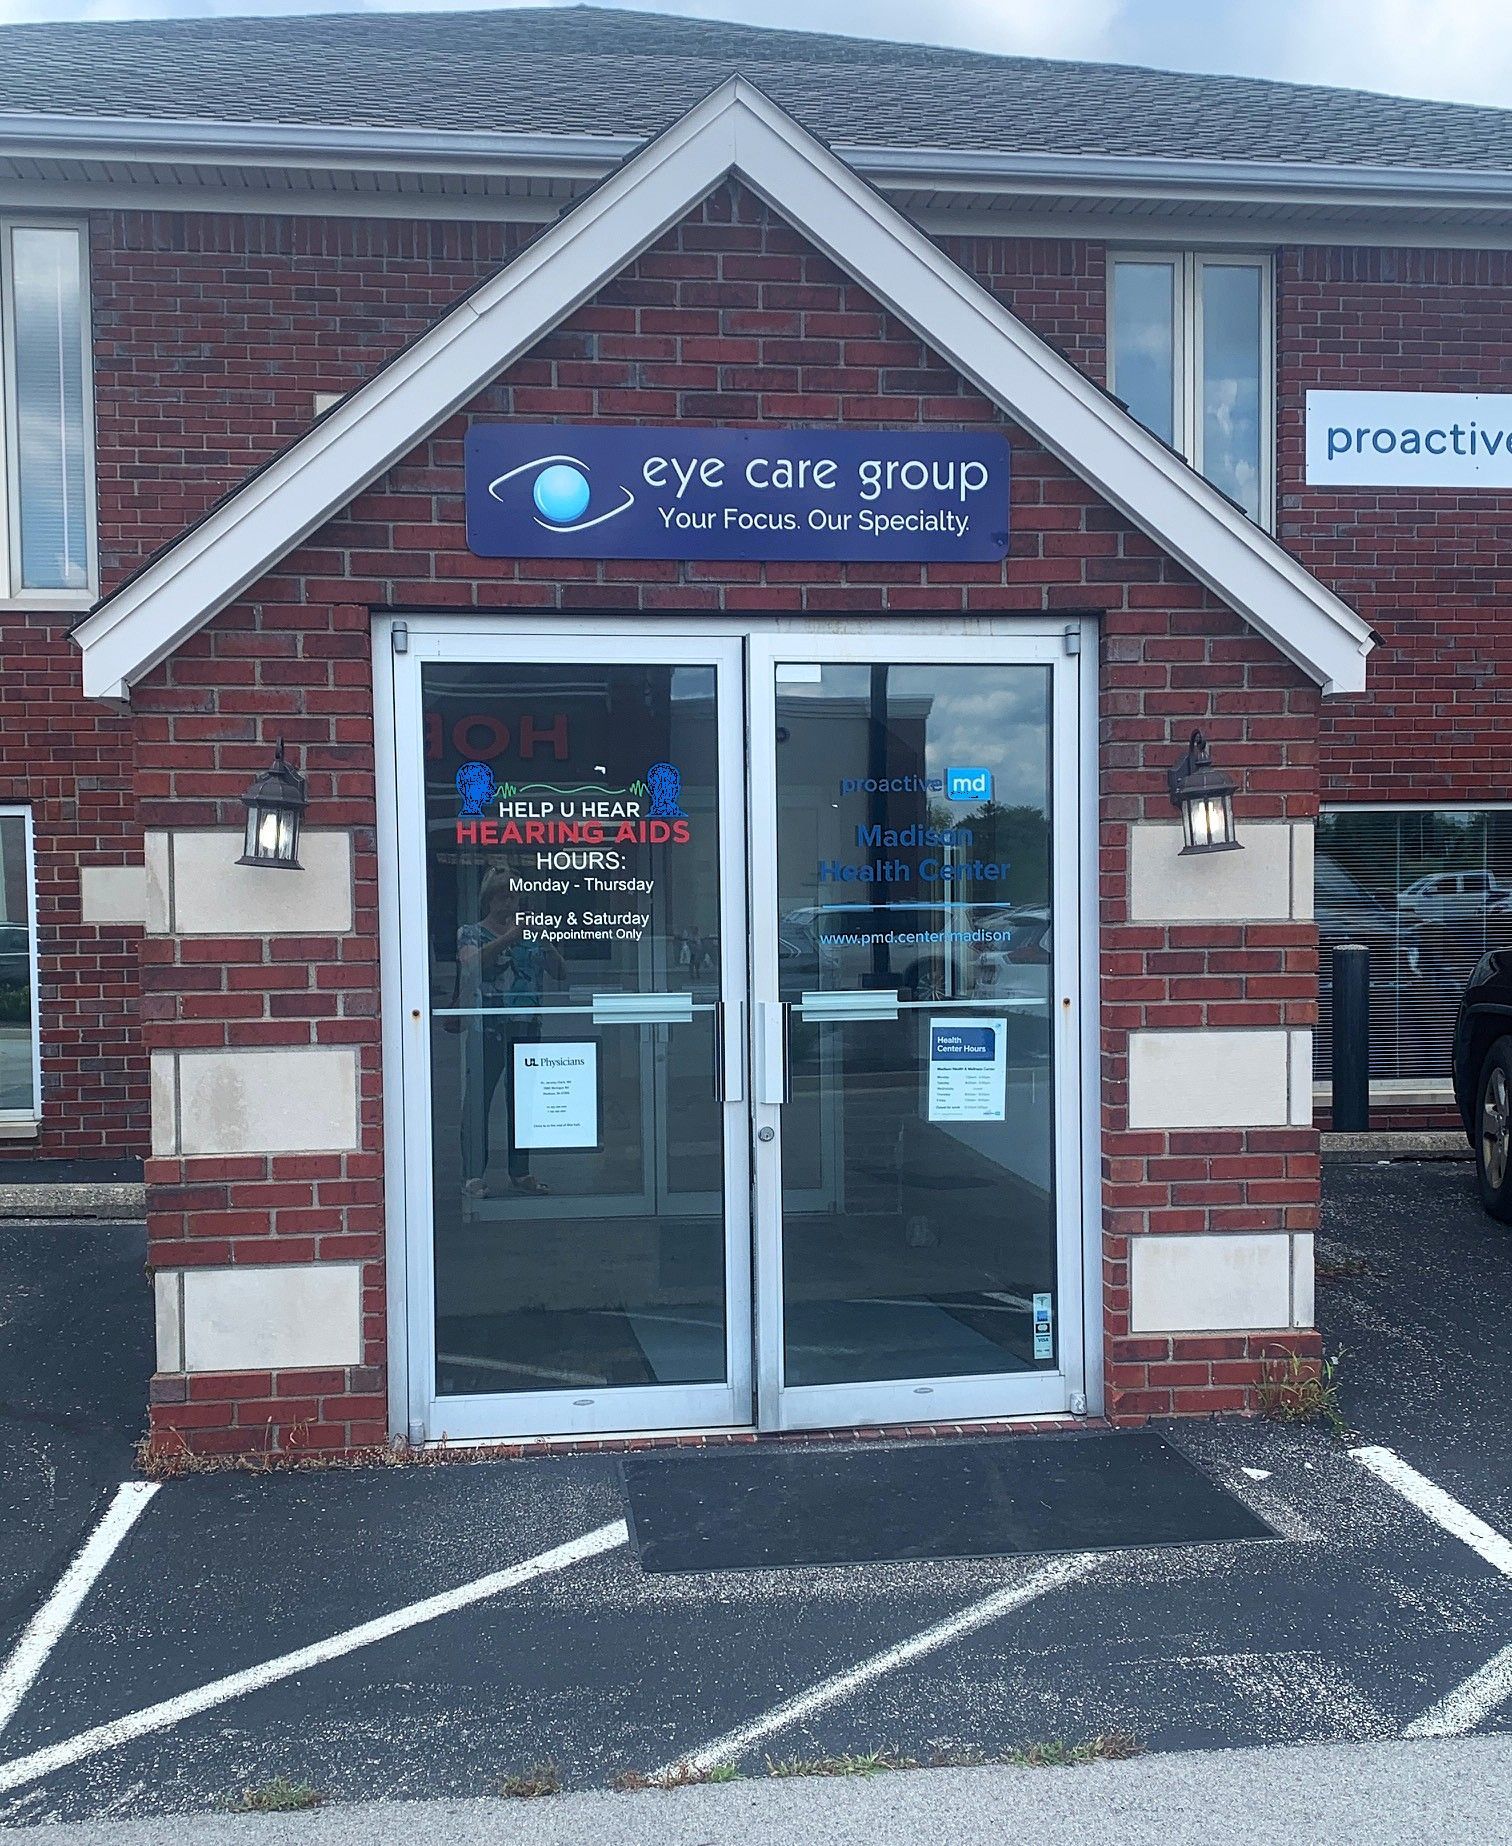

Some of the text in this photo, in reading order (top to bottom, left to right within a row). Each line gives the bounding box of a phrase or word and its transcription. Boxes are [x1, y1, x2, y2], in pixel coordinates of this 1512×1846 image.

[1327, 421, 1512, 460] proactiv
[642, 455, 989, 501] eye care group
[658, 507, 970, 537] Your Focus. Our Specialty.
[842, 774, 986, 796] proactive md
[499, 802, 640, 818] HELP U HEAR
[457, 821, 690, 845] HEARING AIDS
[857, 824, 973, 848] Madison
[536, 852, 626, 870] HOURS:
[820, 858, 1011, 882] Health Center
[509, 877, 569, 894] Monday
[584, 877, 654, 894] Thursday
[515, 912, 650, 928] Friday & Saturday
[523, 928, 642, 941] By Appointment Only
[937, 1036, 962, 1044] Health
[937, 1045, 986, 1053] Center Hours
[540, 1057, 585, 1068] Physicians
